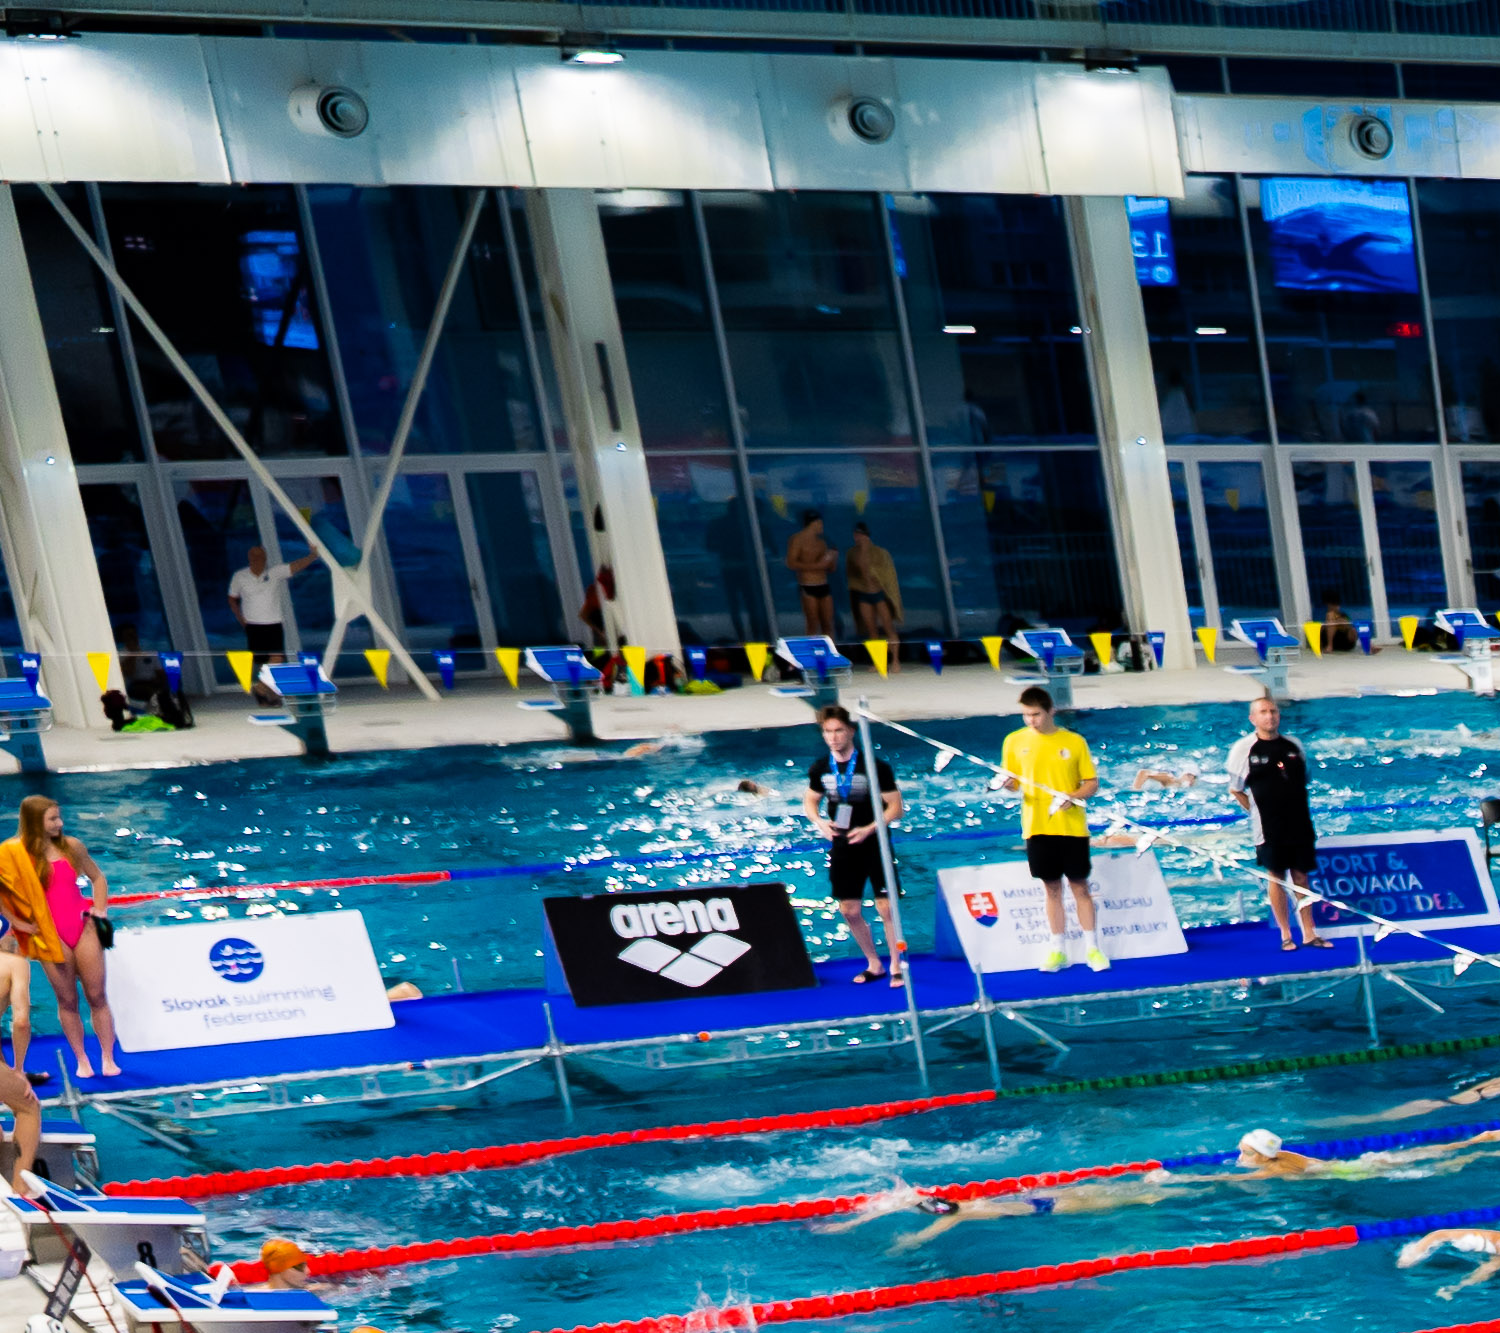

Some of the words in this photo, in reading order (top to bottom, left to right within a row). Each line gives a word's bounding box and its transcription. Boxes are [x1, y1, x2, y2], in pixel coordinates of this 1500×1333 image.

[1387, 851, 1407, 871] &
[1310, 872, 1423, 898] SLOVAKIA
[610, 897, 740, 939] arena
[162, 993, 232, 1013] Slovak
